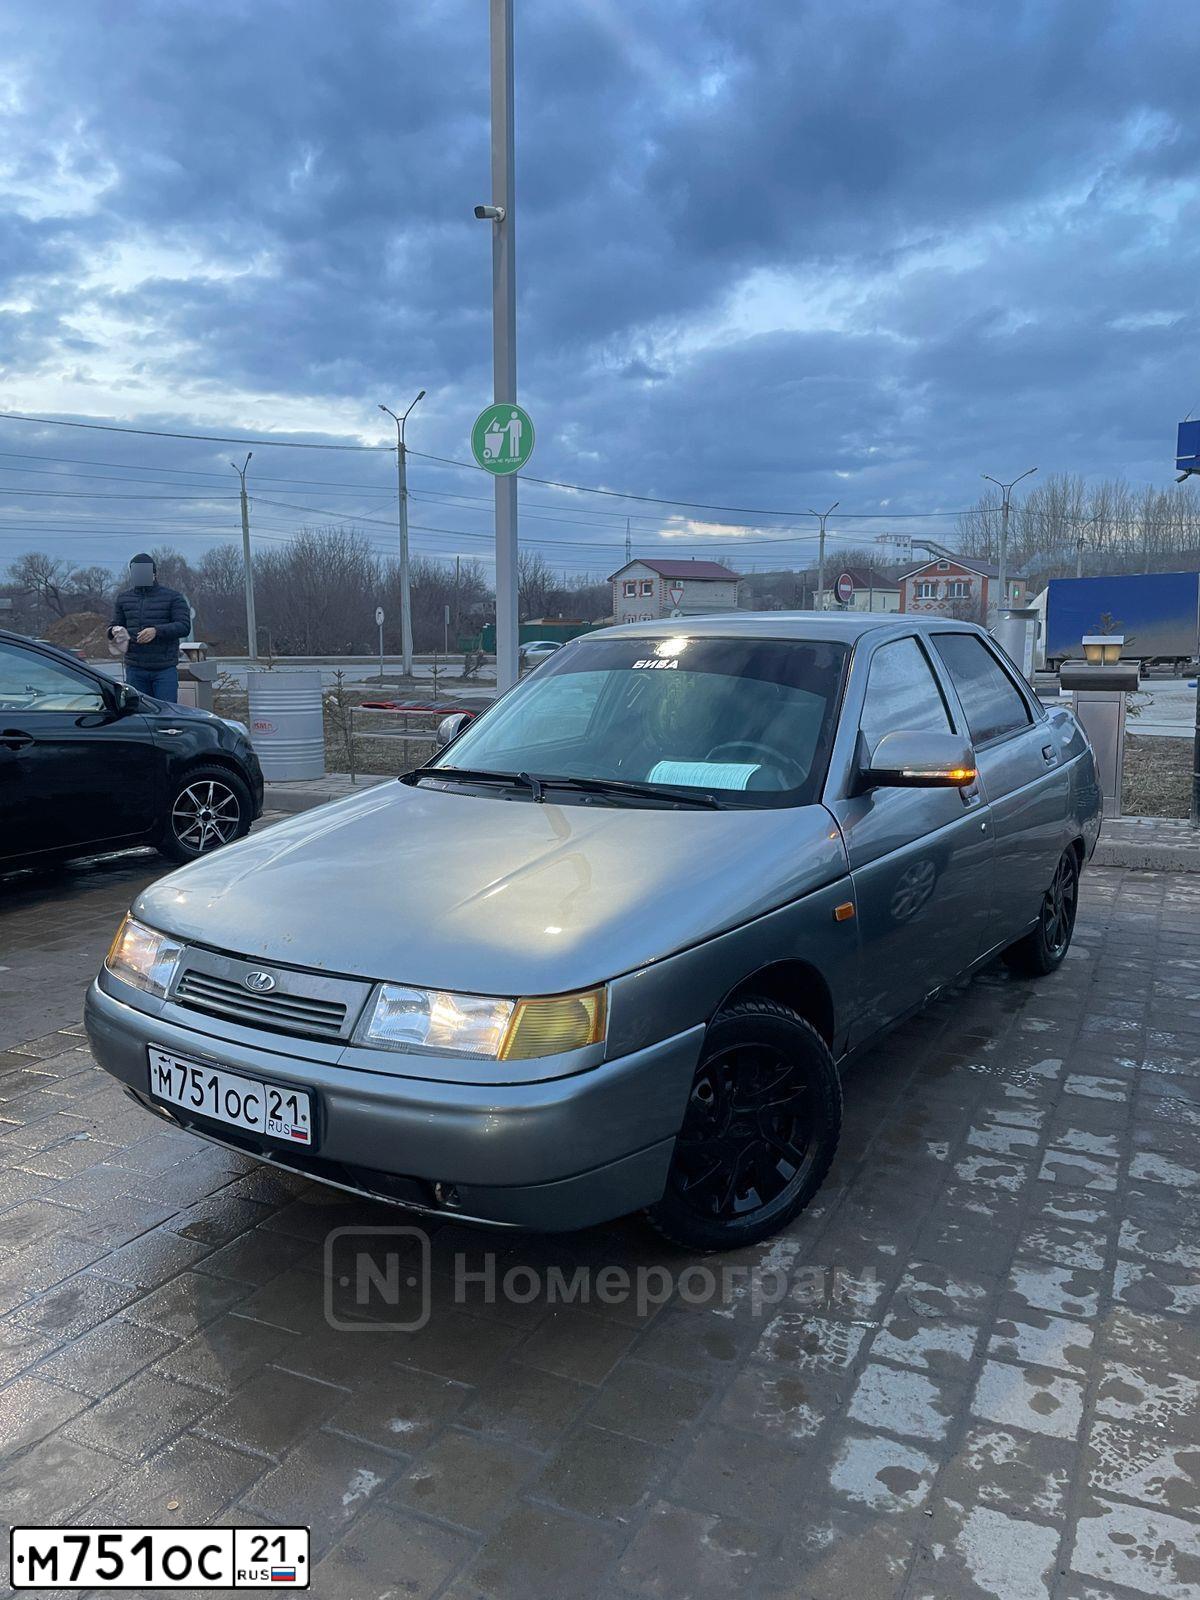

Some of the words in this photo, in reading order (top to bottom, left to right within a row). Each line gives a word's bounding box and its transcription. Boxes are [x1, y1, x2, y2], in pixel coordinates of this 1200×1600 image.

[632, 660, 679, 669] БИВА
[269, 1090, 298, 1125] 21
[268, 1120, 290, 1135] RUS
